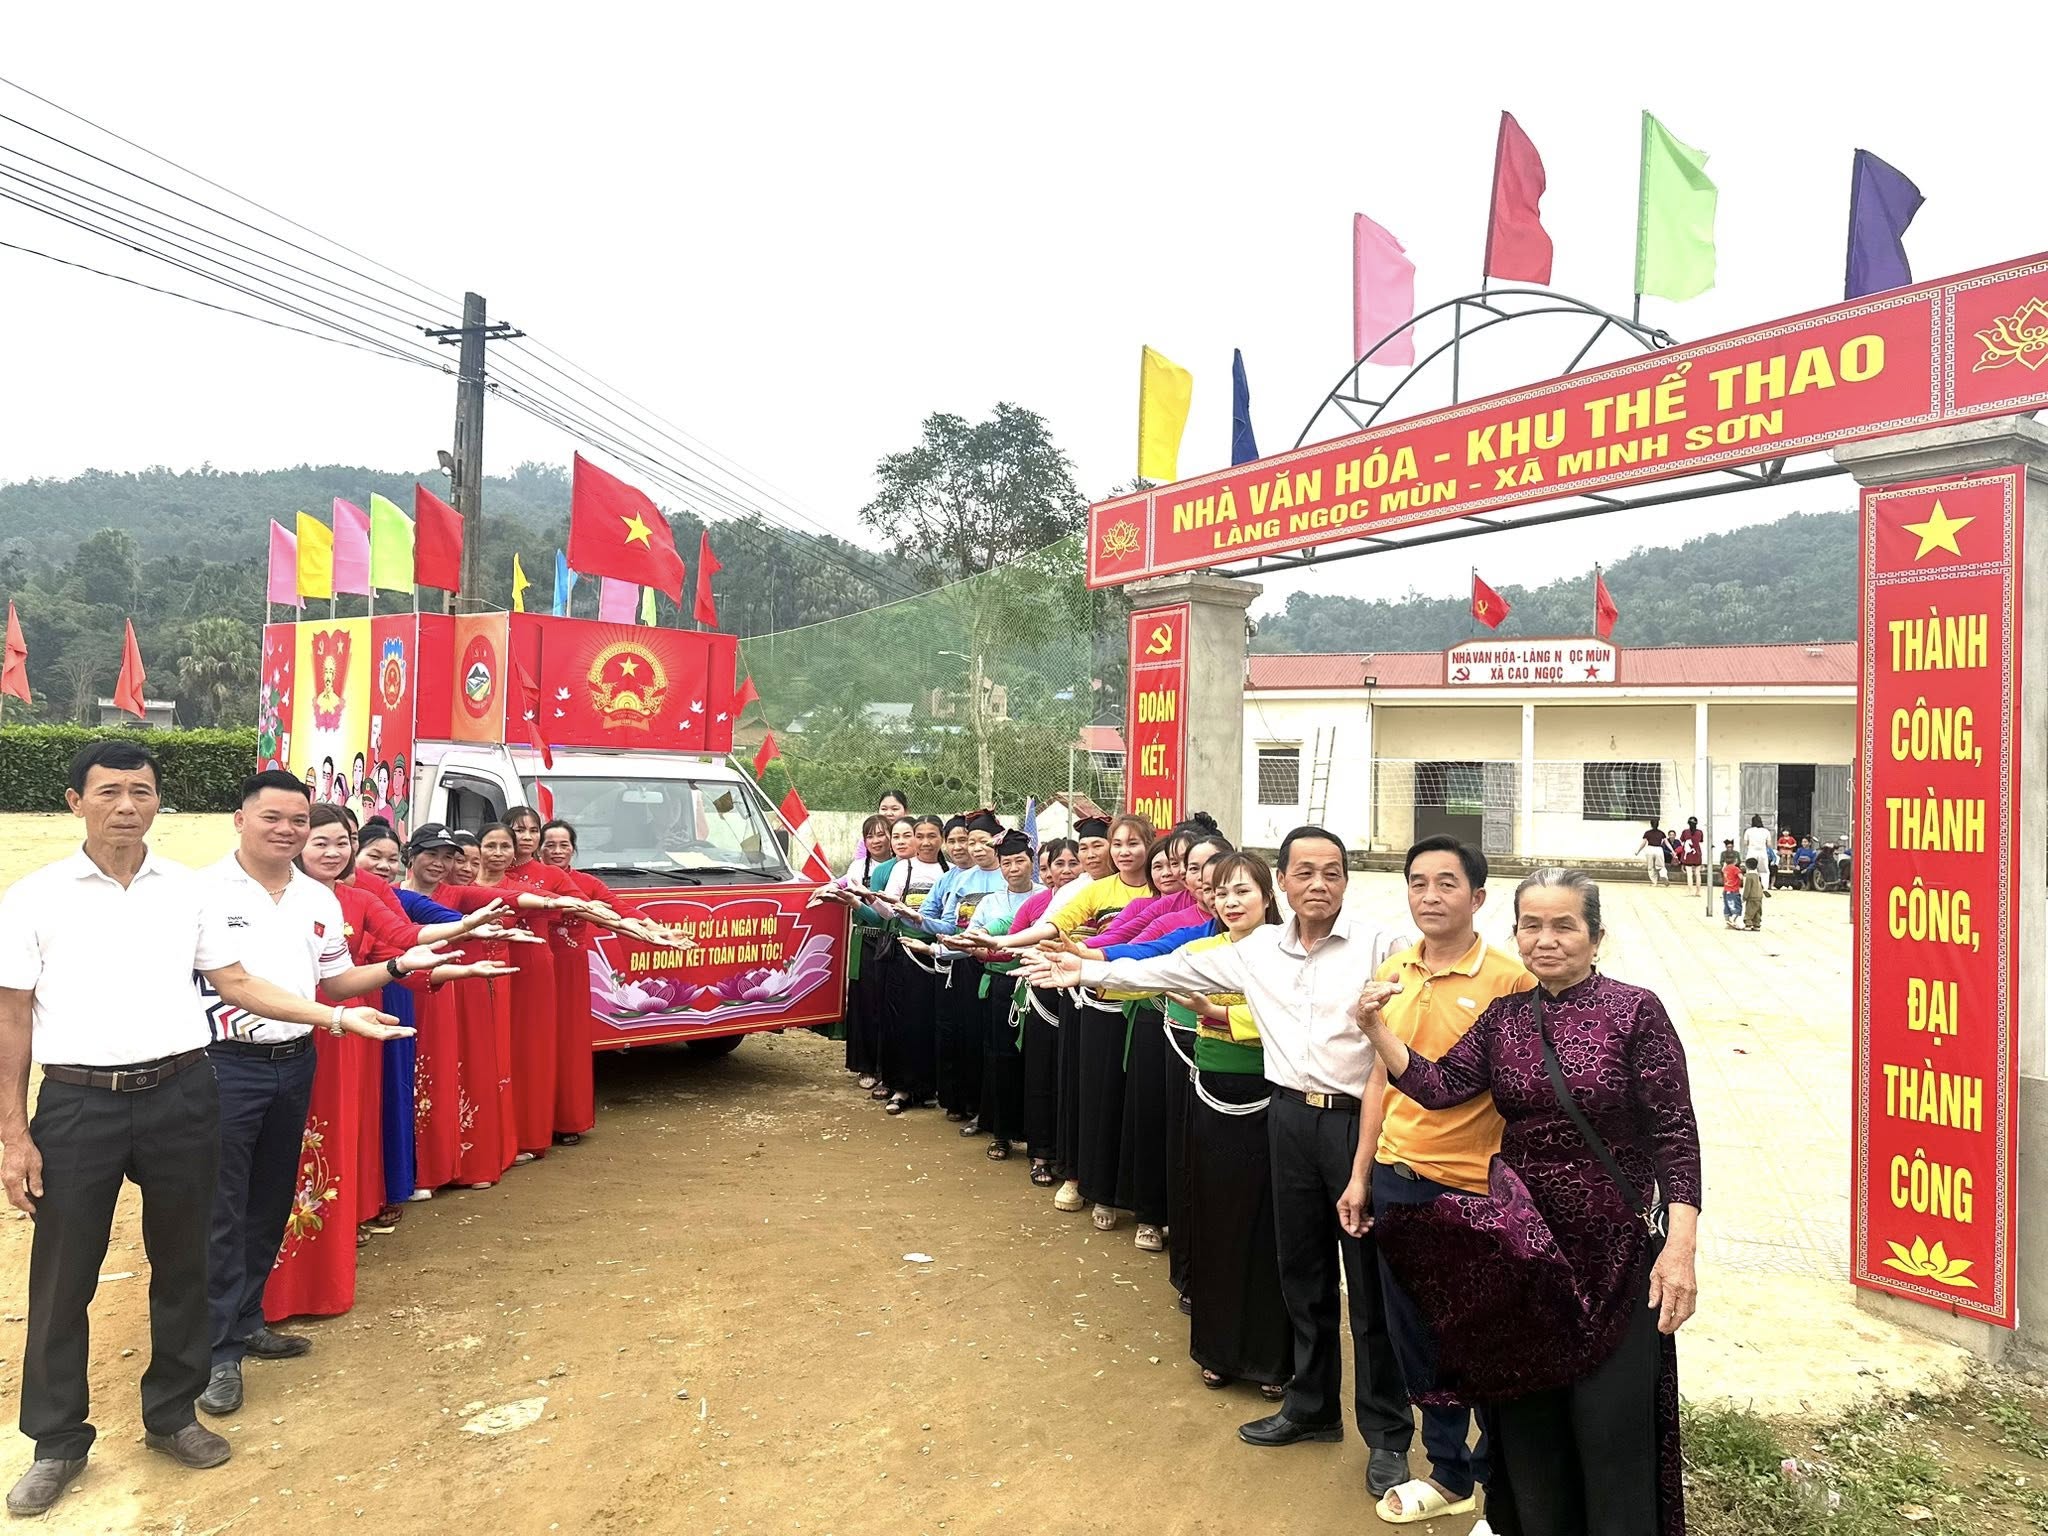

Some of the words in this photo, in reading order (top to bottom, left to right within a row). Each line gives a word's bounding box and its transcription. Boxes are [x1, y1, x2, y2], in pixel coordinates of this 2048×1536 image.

[1172, 486, 1238, 534] NHÀ
[1248, 471, 1321, 516] VĂN
[1336, 446, 1419, 496] HÓA
[1467, 407, 1566, 466] KHU
[1584, 361, 1693, 439] THỂ
[1709, 334, 1885, 411] THAO
[1213, 523, 1280, 549] LÀNG
[1289, 499, 1369, 529] NGỌC
[1379, 479, 1457, 515] MÙN
[1494, 457, 1542, 490] XÃ
[1558, 433, 1668, 476] MINH
[1685, 409, 1783, 451] SƠN
[1494, 648, 1516, 664] HÓA
[1586, 646, 1610, 662] MÙN
[1888, 606, 1988, 672] THÀNH
[1138, 685, 1176, 724] ĐOÀN
[1508, 667, 1529, 680] CAO
[1141, 732, 1169, 780] KẾT,
[1891, 696, 1983, 767] CÔNG,
[1885, 786, 1985, 853] THÀNH
[699, 914, 715, 939] CỬ
[715, 916, 728, 939] LÀ
[731, 915, 759, 938] NGÀY
[760, 914, 778, 938] HỘI
[1888, 876, 1980, 952] CÔNG,
[630, 951, 651, 975] ĐẠI
[653, 947, 683, 970] ĐOÀN
[708, 943, 735, 966] TOÀN
[737, 941, 759, 963] DÂN
[761, 940, 784, 964] TỘC!
[1907, 977, 1958, 1046] ĐẠI
[1882, 1058, 1983, 1133] THÀNH
[1890, 1147, 1974, 1224] CÔNG
